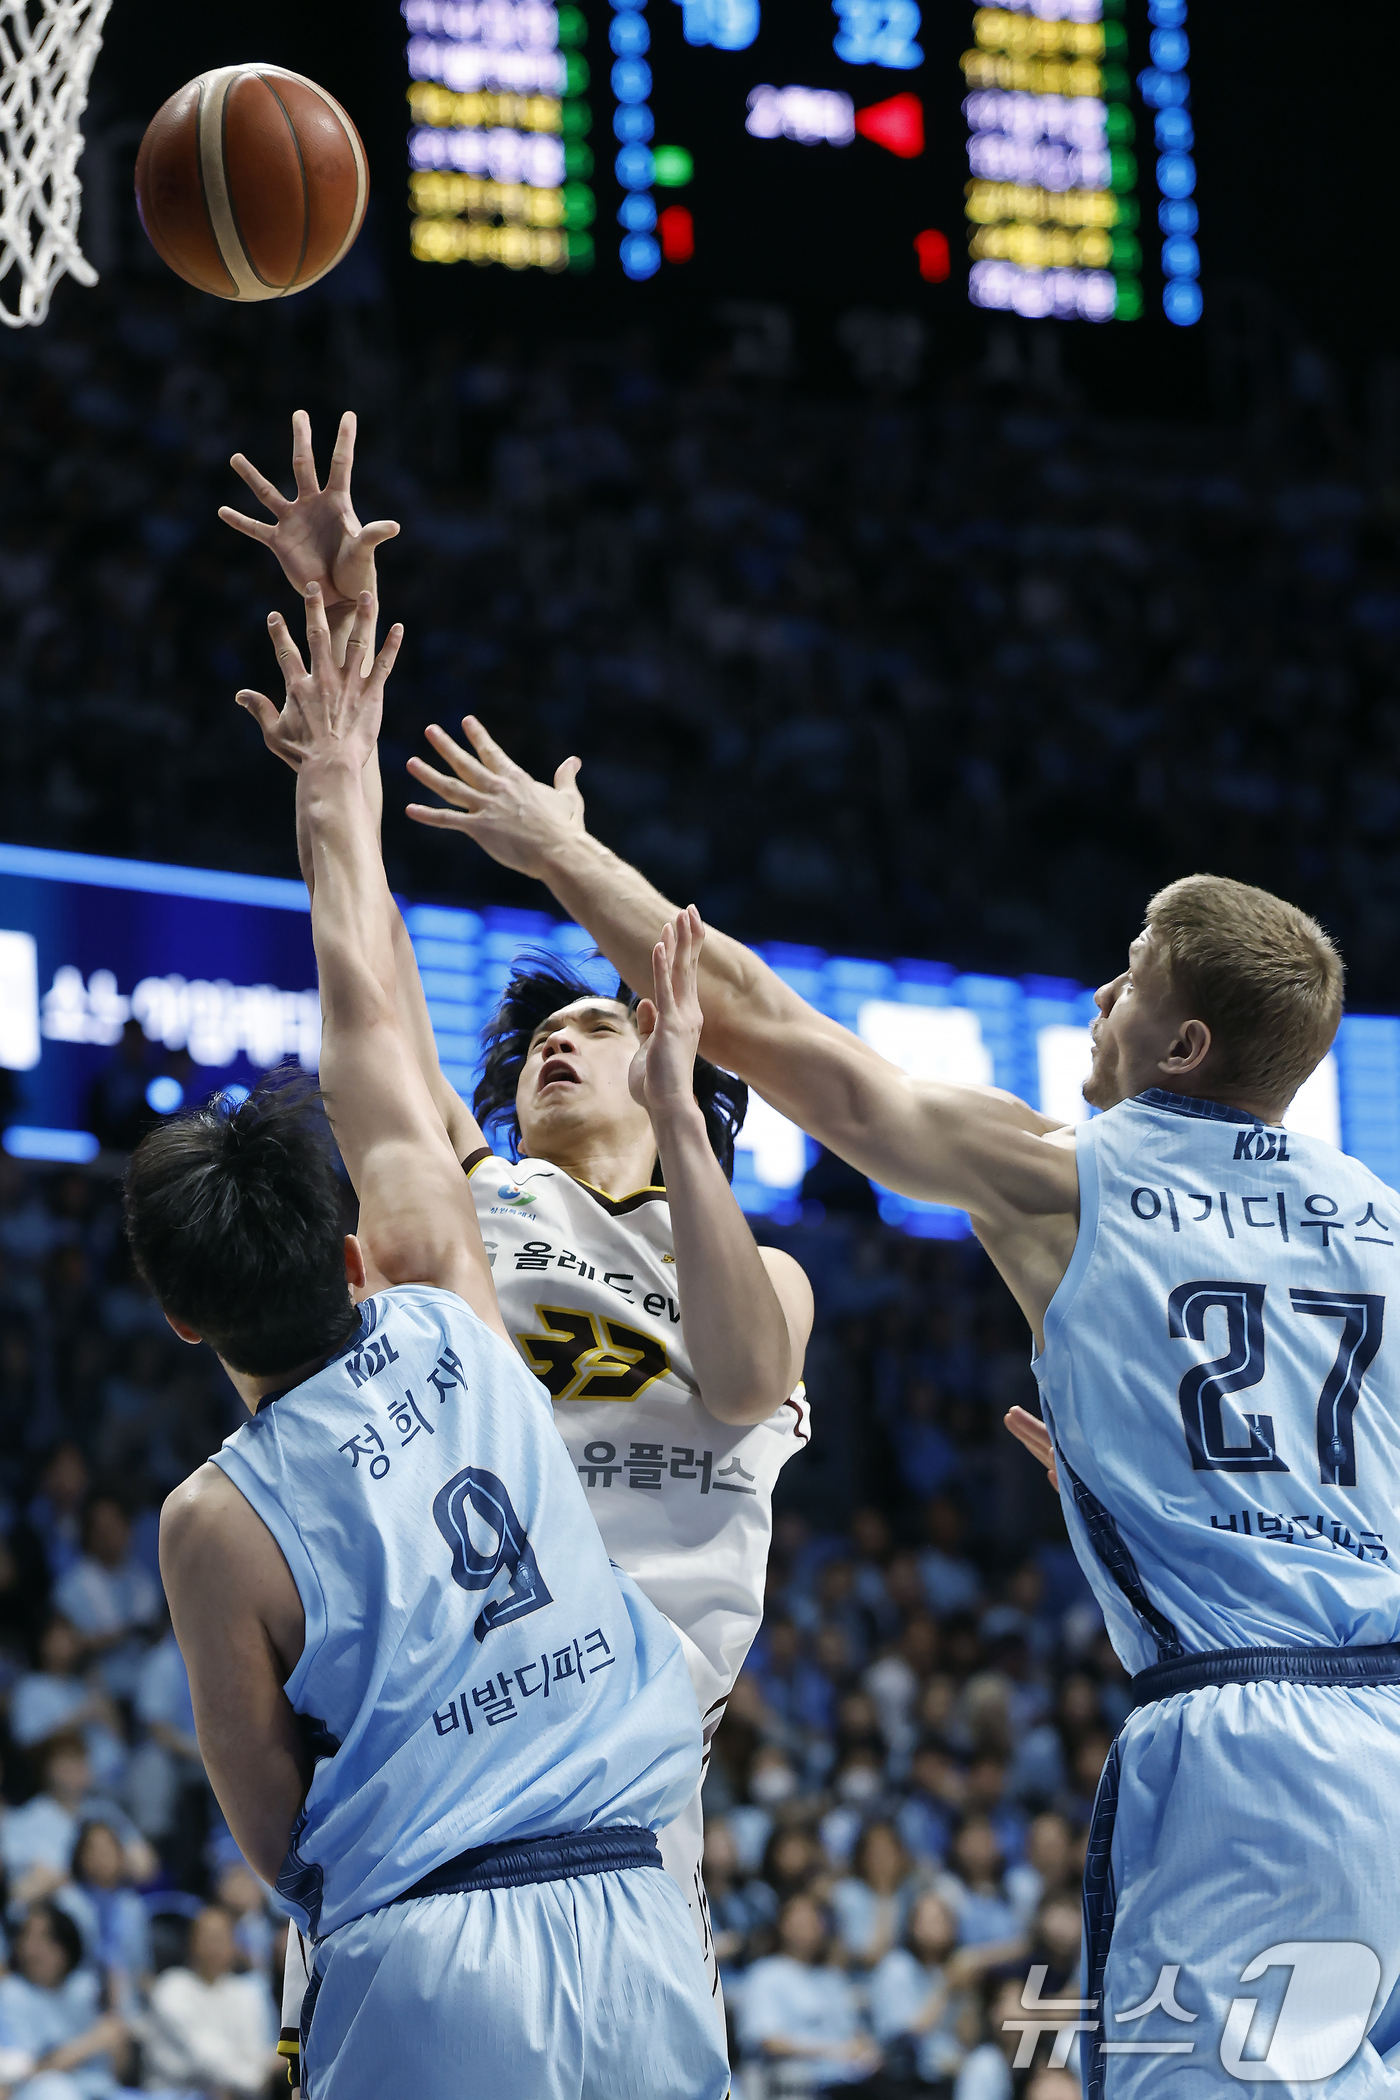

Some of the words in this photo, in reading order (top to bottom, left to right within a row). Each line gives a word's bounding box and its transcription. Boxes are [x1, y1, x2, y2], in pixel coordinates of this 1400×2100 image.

[1232, 1127, 1290, 1162] KBL
[1130, 1186, 1394, 1247] 이기디우스
[514, 1241, 635, 1304] 올레드
[344, 1333, 400, 1389] KBL
[1168, 1279, 1386, 1488] 27
[338, 1346, 469, 1481] 정희재
[578, 1441, 757, 1495] 유플러스
[432, 1465, 554, 1645] 9
[432, 1627, 617, 1736] 비발디파크
